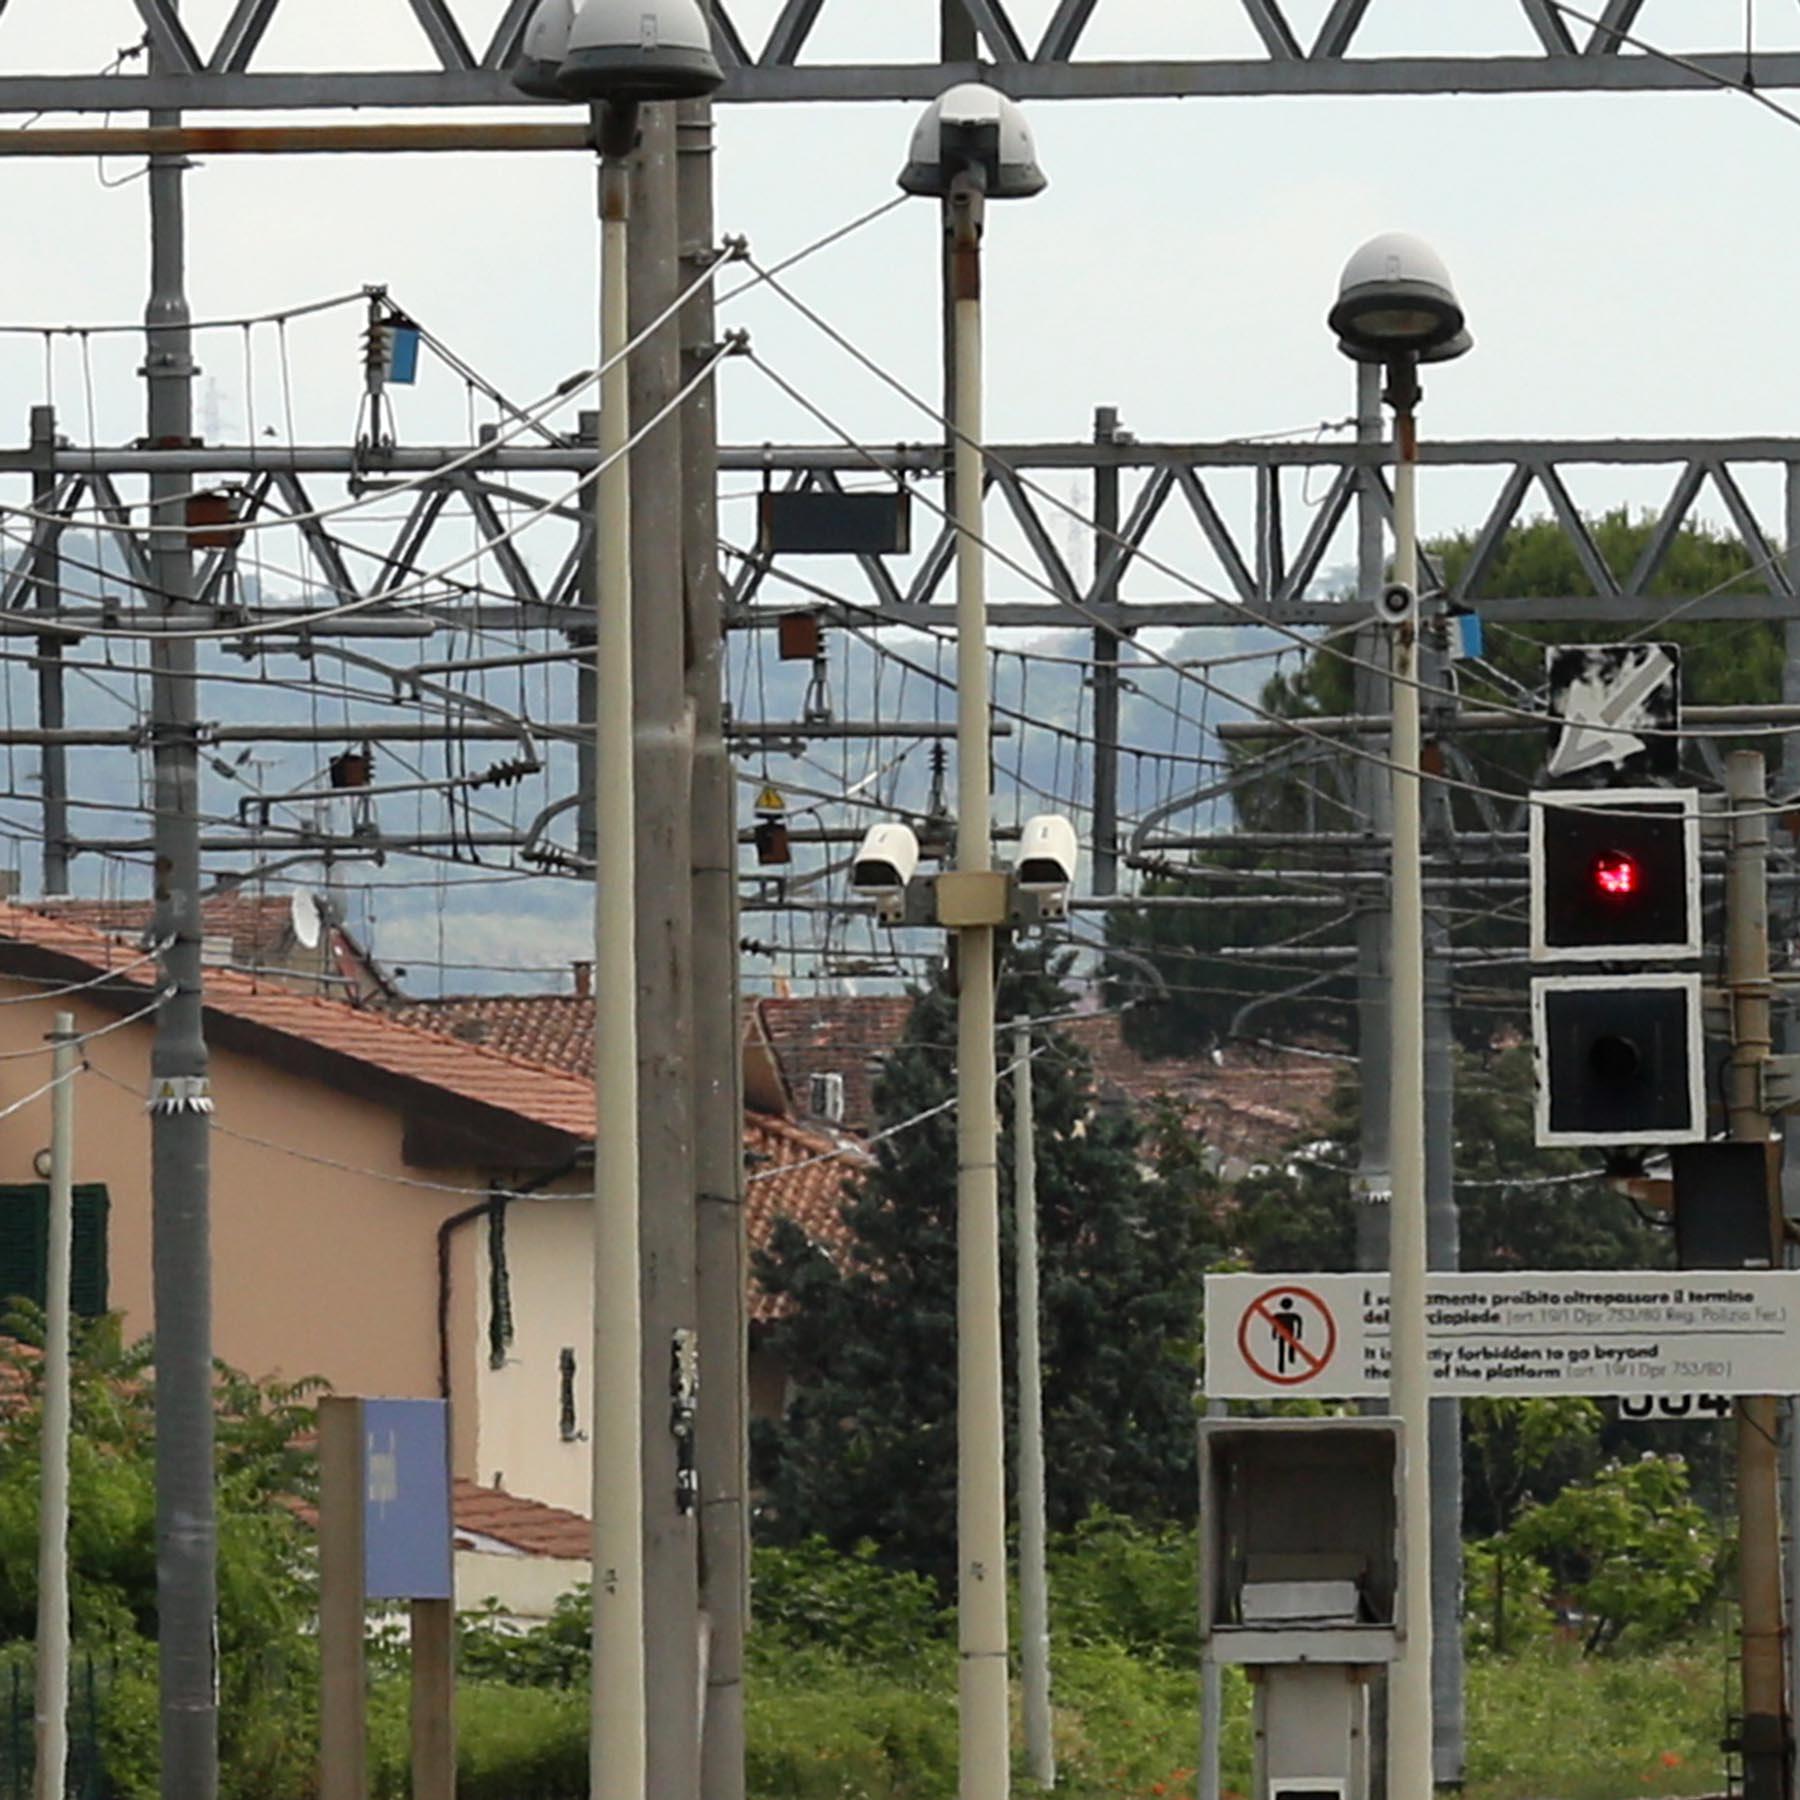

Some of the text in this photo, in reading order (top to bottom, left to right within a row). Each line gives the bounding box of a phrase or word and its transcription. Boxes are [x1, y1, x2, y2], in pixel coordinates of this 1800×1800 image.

[1492, 1290, 1560, 1306] proibito
[1687, 1289, 1755, 1304] termine
[1457, 1345, 1542, 1361] forbidden
[1546, 1347, 1565, 1361] to
[1567, 1348, 1591, 1364] go
[1594, 1344, 1660, 1362] beyond
[1433, 1363, 1451, 1379] of
[1455, 1364, 1482, 1378] the
[1486, 1362, 1561, 1382] platform
